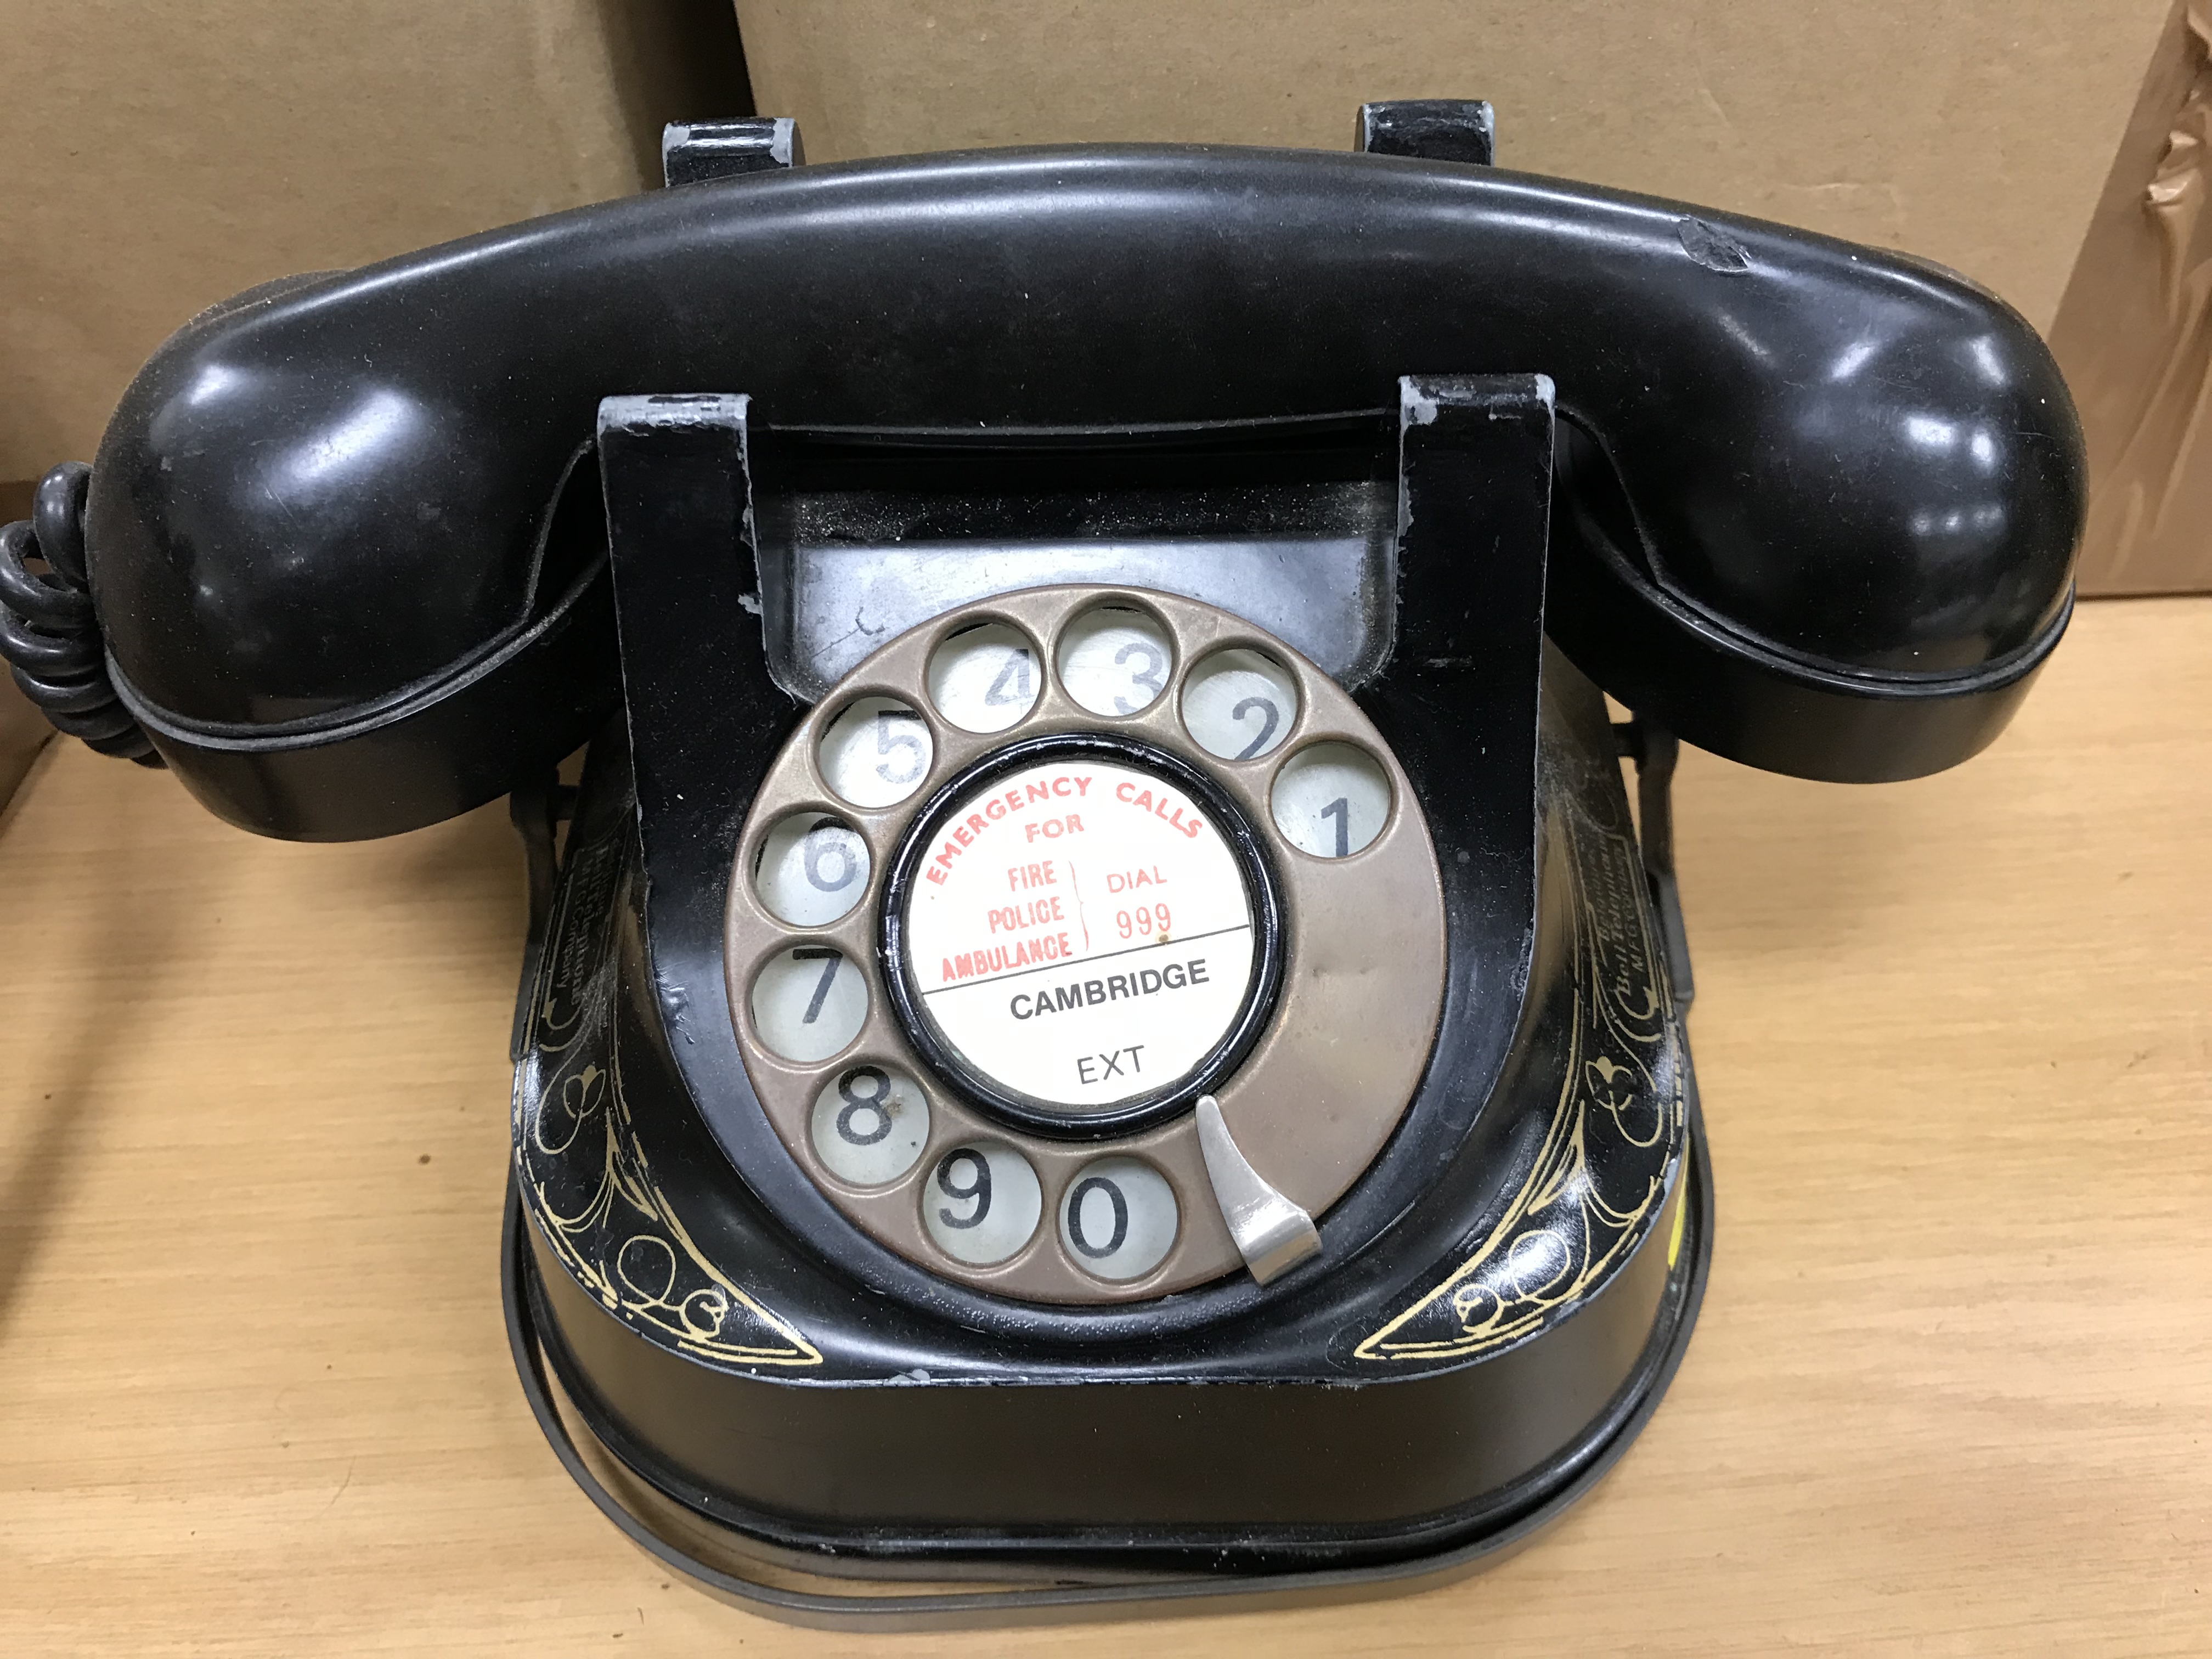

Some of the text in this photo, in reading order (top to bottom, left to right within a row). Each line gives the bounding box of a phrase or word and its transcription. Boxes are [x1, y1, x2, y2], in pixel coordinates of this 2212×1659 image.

[984, 648, 1032, 707] 4
[1113, 641, 1164, 716] 3
[876, 710, 927, 784] 5
[1231, 696, 1280, 761] 2
[804, 816, 857, 893] 6
[926, 777, 1203, 885] EMERGENCY CALLS
[1025, 814, 1084, 843] FOR
[1320, 798, 1350, 859] 1
[1007, 861, 1057, 891] FIRE
[1107, 866, 1167, 893] DIAL
[987, 896, 1064, 933] POLICE
[1116, 903, 1171, 939] 999
[792, 947, 841, 1024] 7
[941, 932, 1073, 981] AMBULANCE
[1010, 959, 1210, 1019] CAMBRIDGE
[1077, 1045, 1145, 1084] EXT
[836, 1065, 893, 1147] 8
[936, 1147, 992, 1231] 9
[1068, 1176, 1129, 1260] 0
